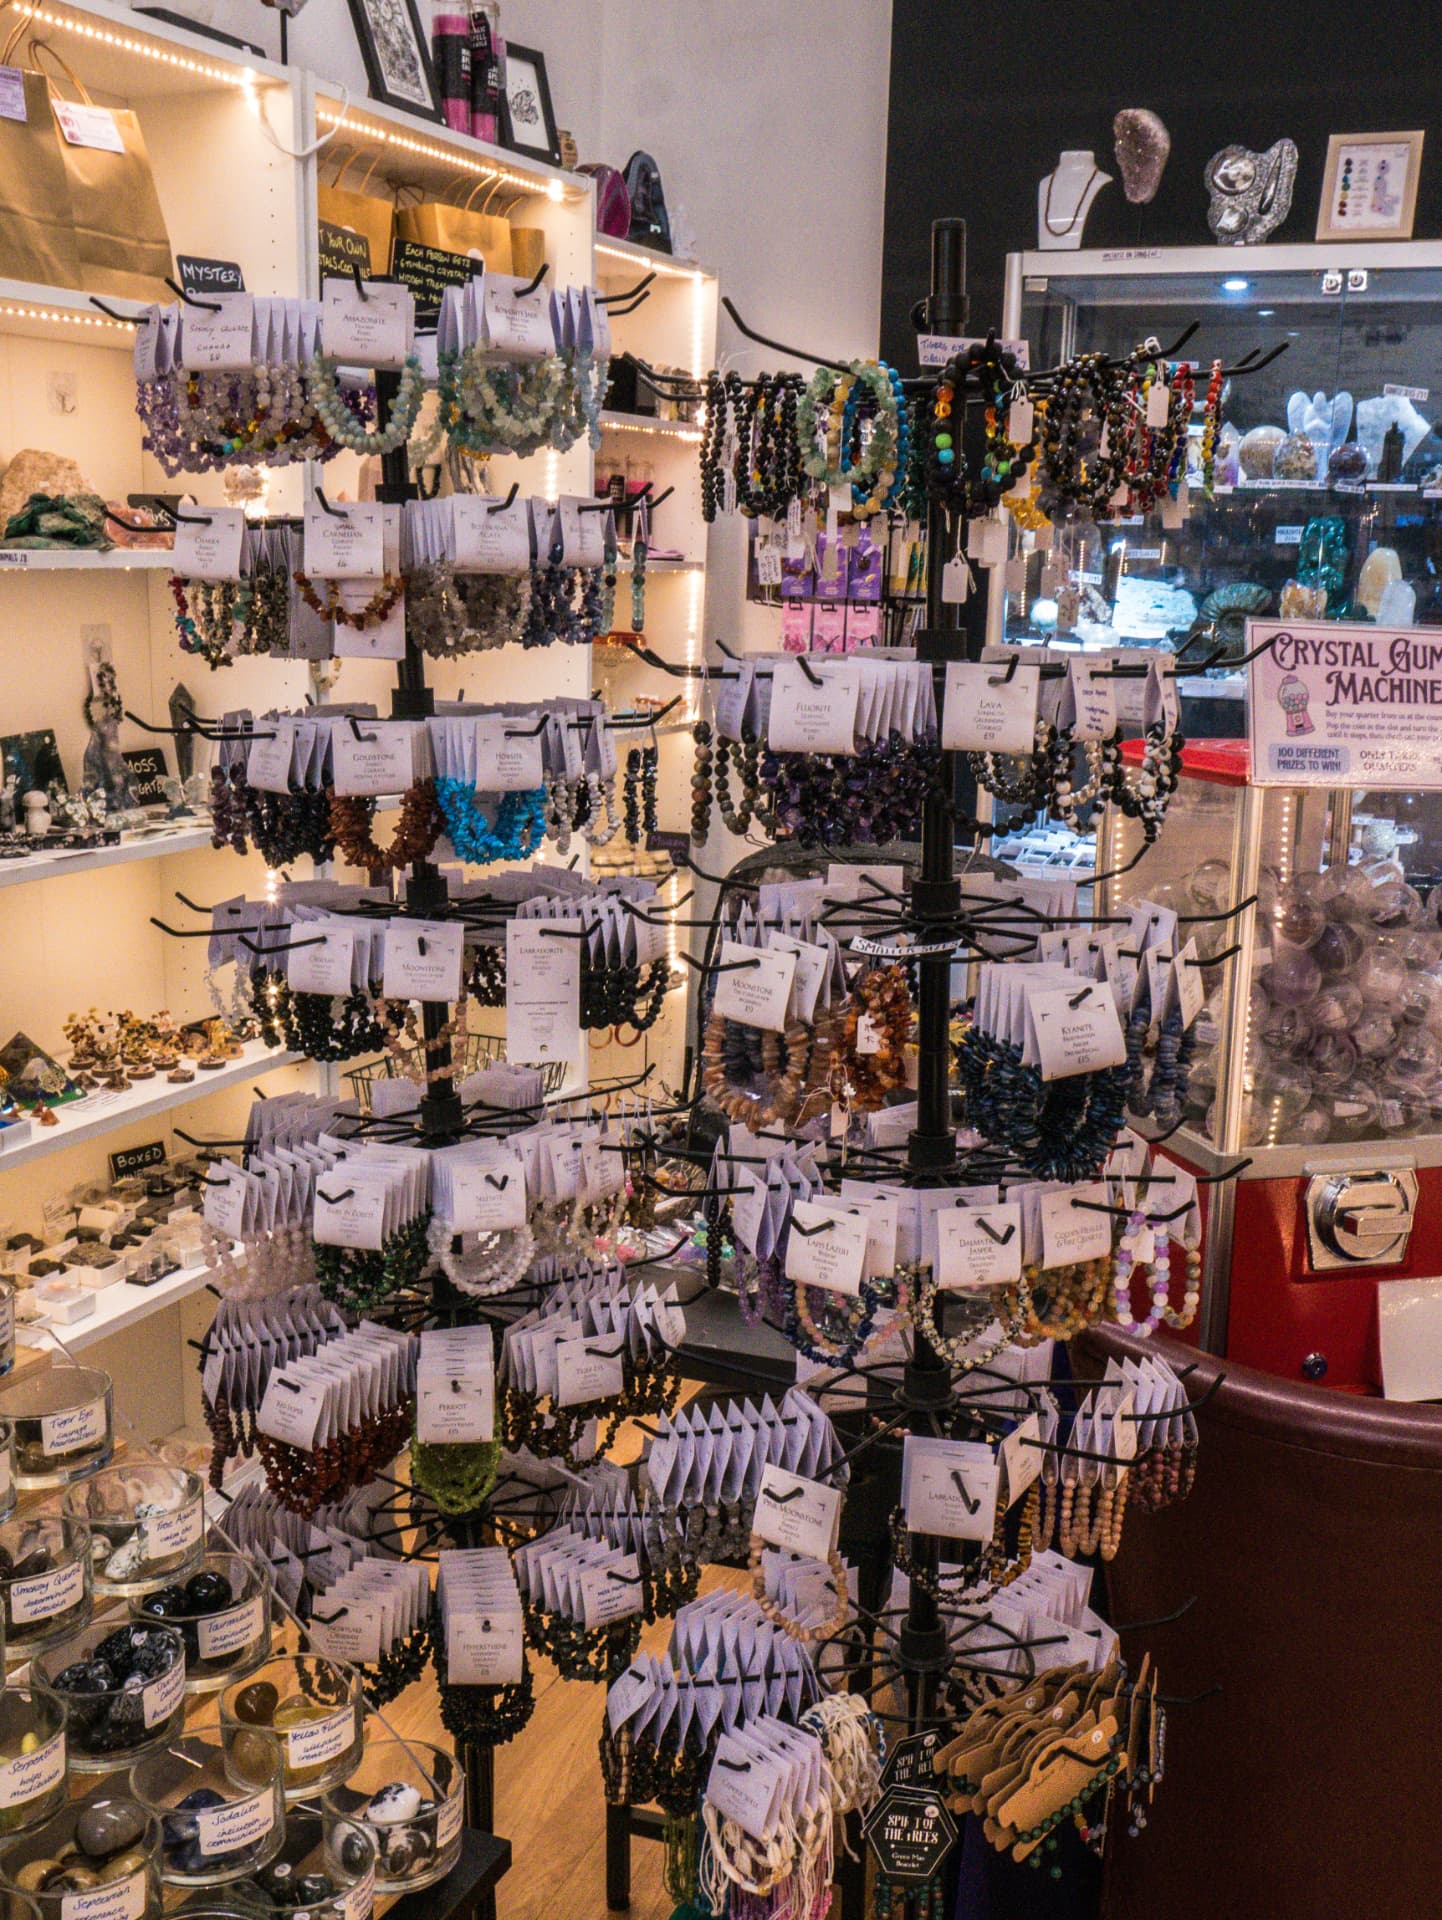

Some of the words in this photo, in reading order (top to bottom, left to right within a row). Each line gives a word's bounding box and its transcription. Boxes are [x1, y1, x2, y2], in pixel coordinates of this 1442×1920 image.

[405, 243, 424, 257] EACH
[182, 263, 242, 288] MYSTERY
[322, 529, 363, 539] CARNELIAN
[1270, 632, 1379, 671] CRYSTAL
[1325, 670, 1442, 706] MACHINE
[979, 700, 1002, 709] LAVA
[1356, 712, 1379, 720] quarter
[1278, 747, 1294, 758] 100
[1296, 748, 1340, 759] DIFFERENT
[1277, 760, 1306, 771] PRIZES
[1308, 761, 1319, 769] TO
[732, 978, 773, 996] MOONSTONE
[1061, 1024, 1093, 1035] KYANITE
[117, 1148, 162, 1168] BOXED
[780, 1504, 823, 1528] MOONSTONE
[212, 1802, 261, 1826] Sodalite
[884, 1827, 904, 1842] THE
